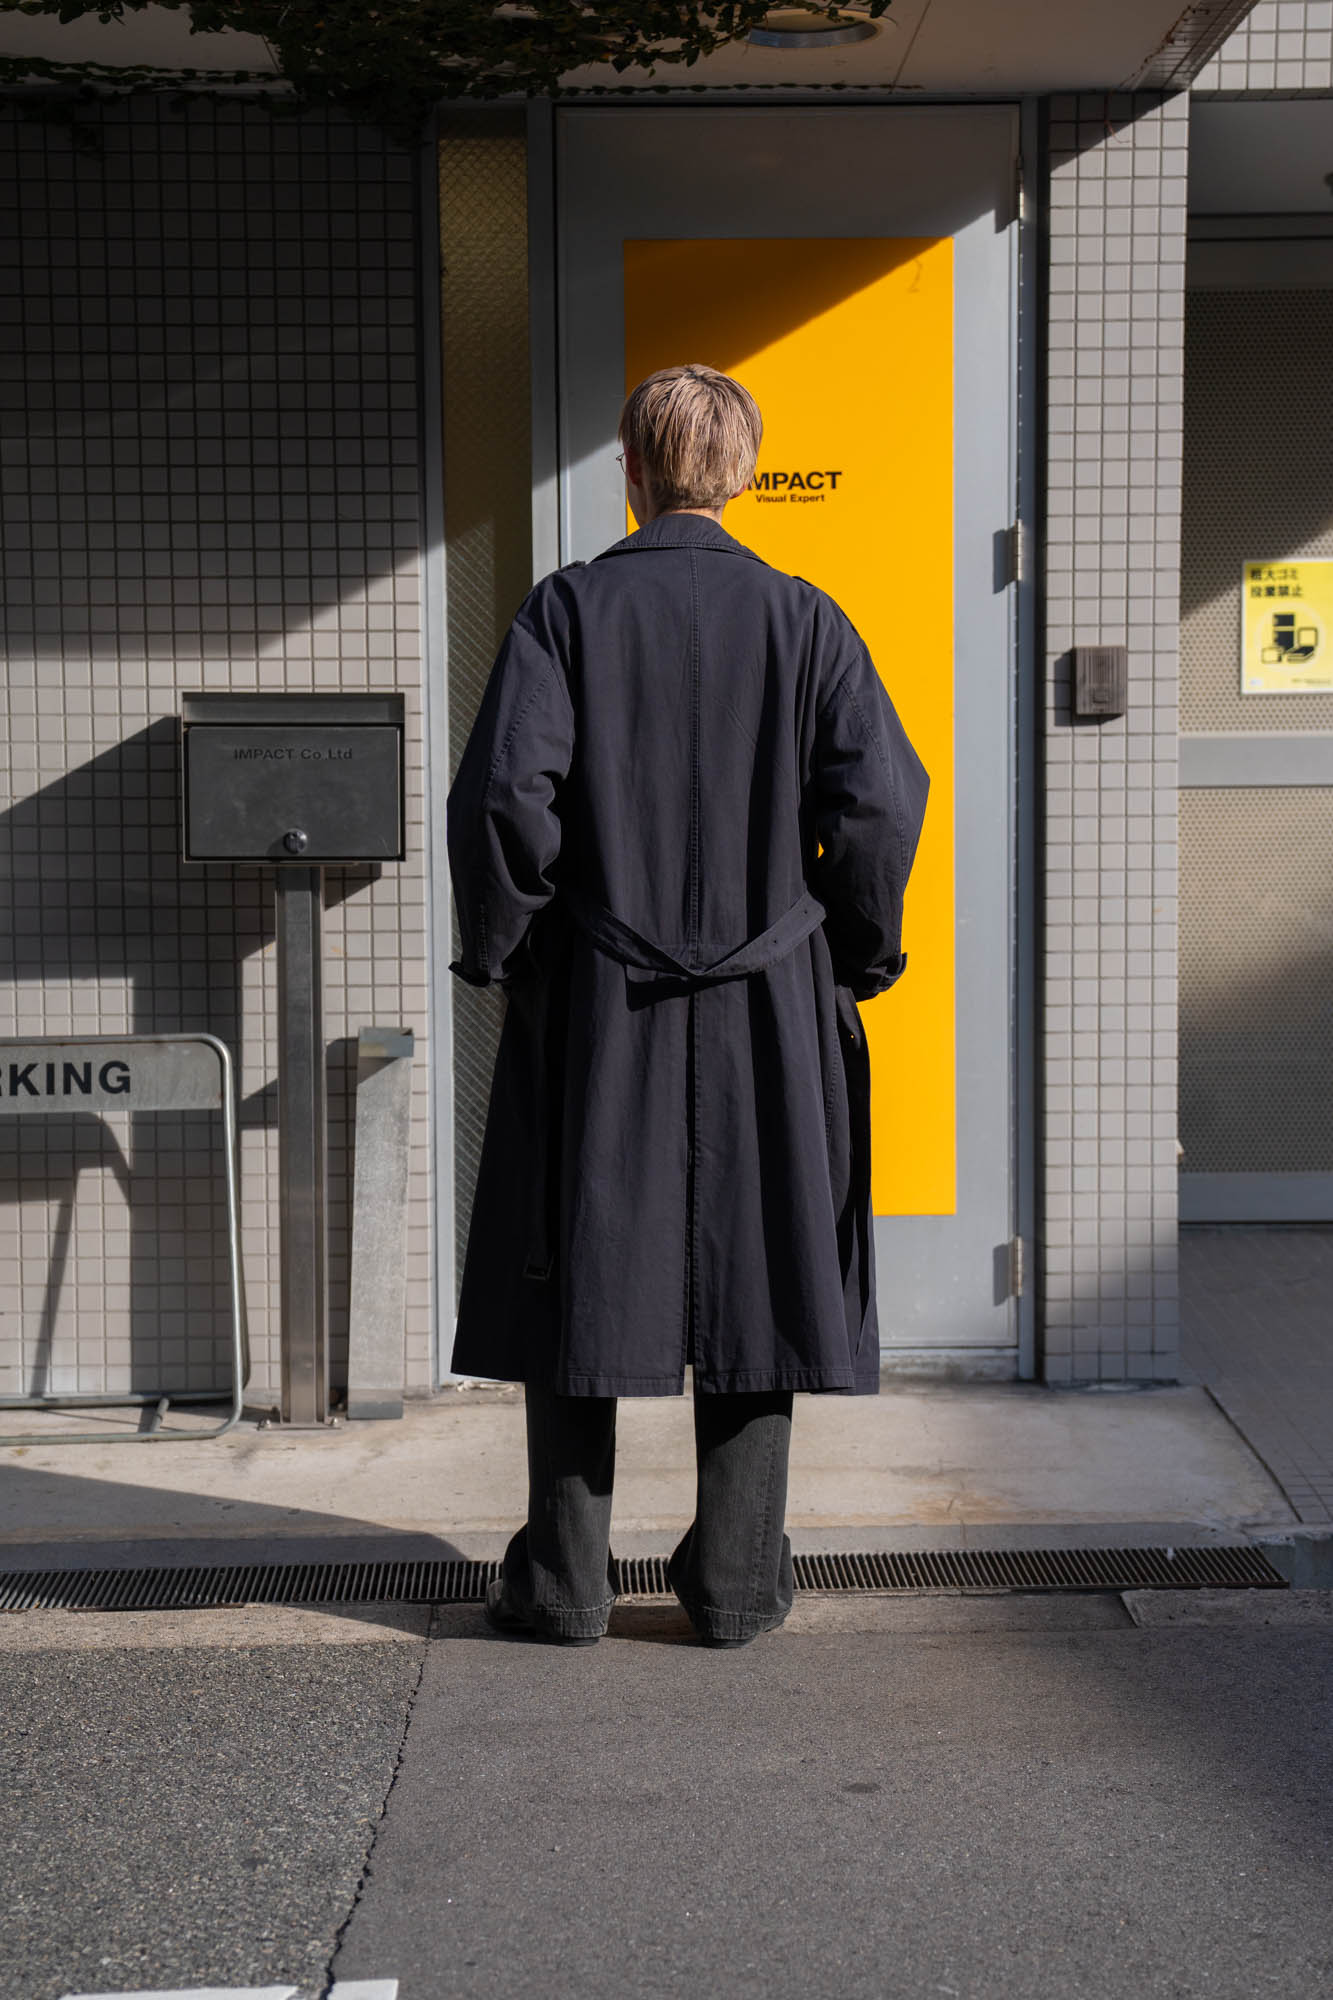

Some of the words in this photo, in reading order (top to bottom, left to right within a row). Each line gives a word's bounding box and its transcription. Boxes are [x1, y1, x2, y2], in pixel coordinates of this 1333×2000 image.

[748, 471, 842, 490] MPACT
[756, 494, 787, 503] Visual
[790, 494, 825, 504] Expert
[234, 747, 295, 761] IMPACT
[0, 1060, 131, 1097] KING
